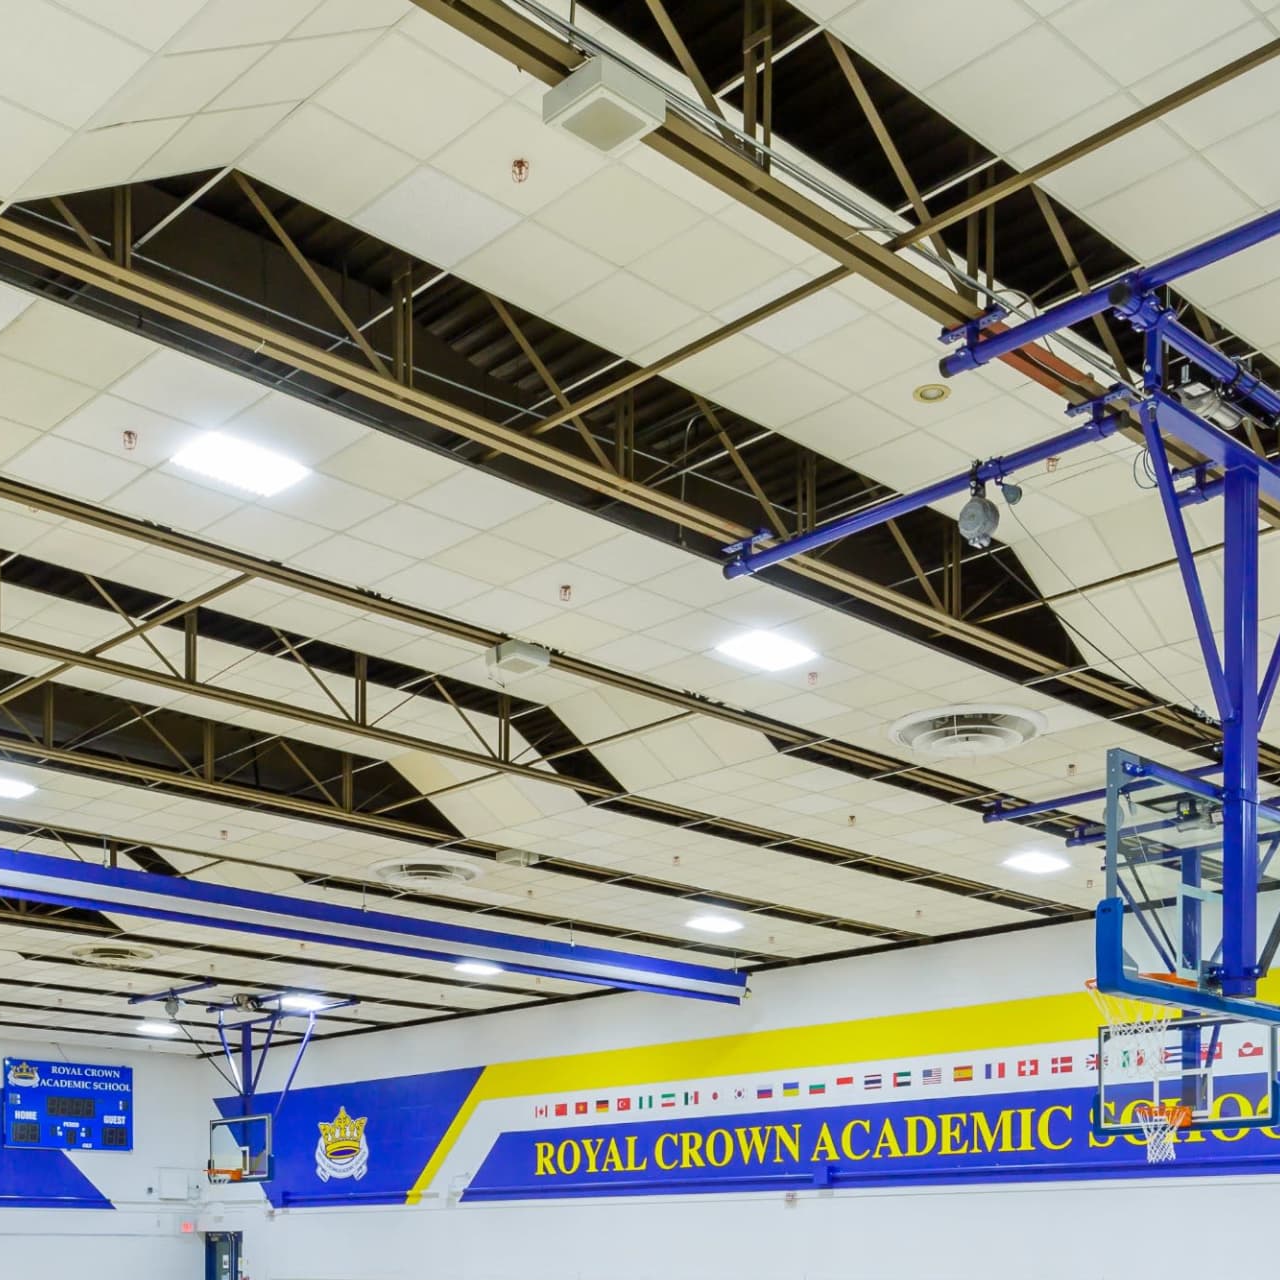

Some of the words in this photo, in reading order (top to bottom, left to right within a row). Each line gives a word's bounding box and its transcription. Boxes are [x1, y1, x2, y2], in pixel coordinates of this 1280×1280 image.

[51, 1065, 83, 1076] ROYAL
[84, 1067, 120, 1079] CROWN
[39, 1078, 92, 1089] ACADEMIC
[92, 1081, 131, 1092] SCHOOL
[533, 1135, 648, 1177] ROYAL
[653, 1123, 802, 1171] CROWN
[810, 1105, 1073, 1163] ACADEMIC
